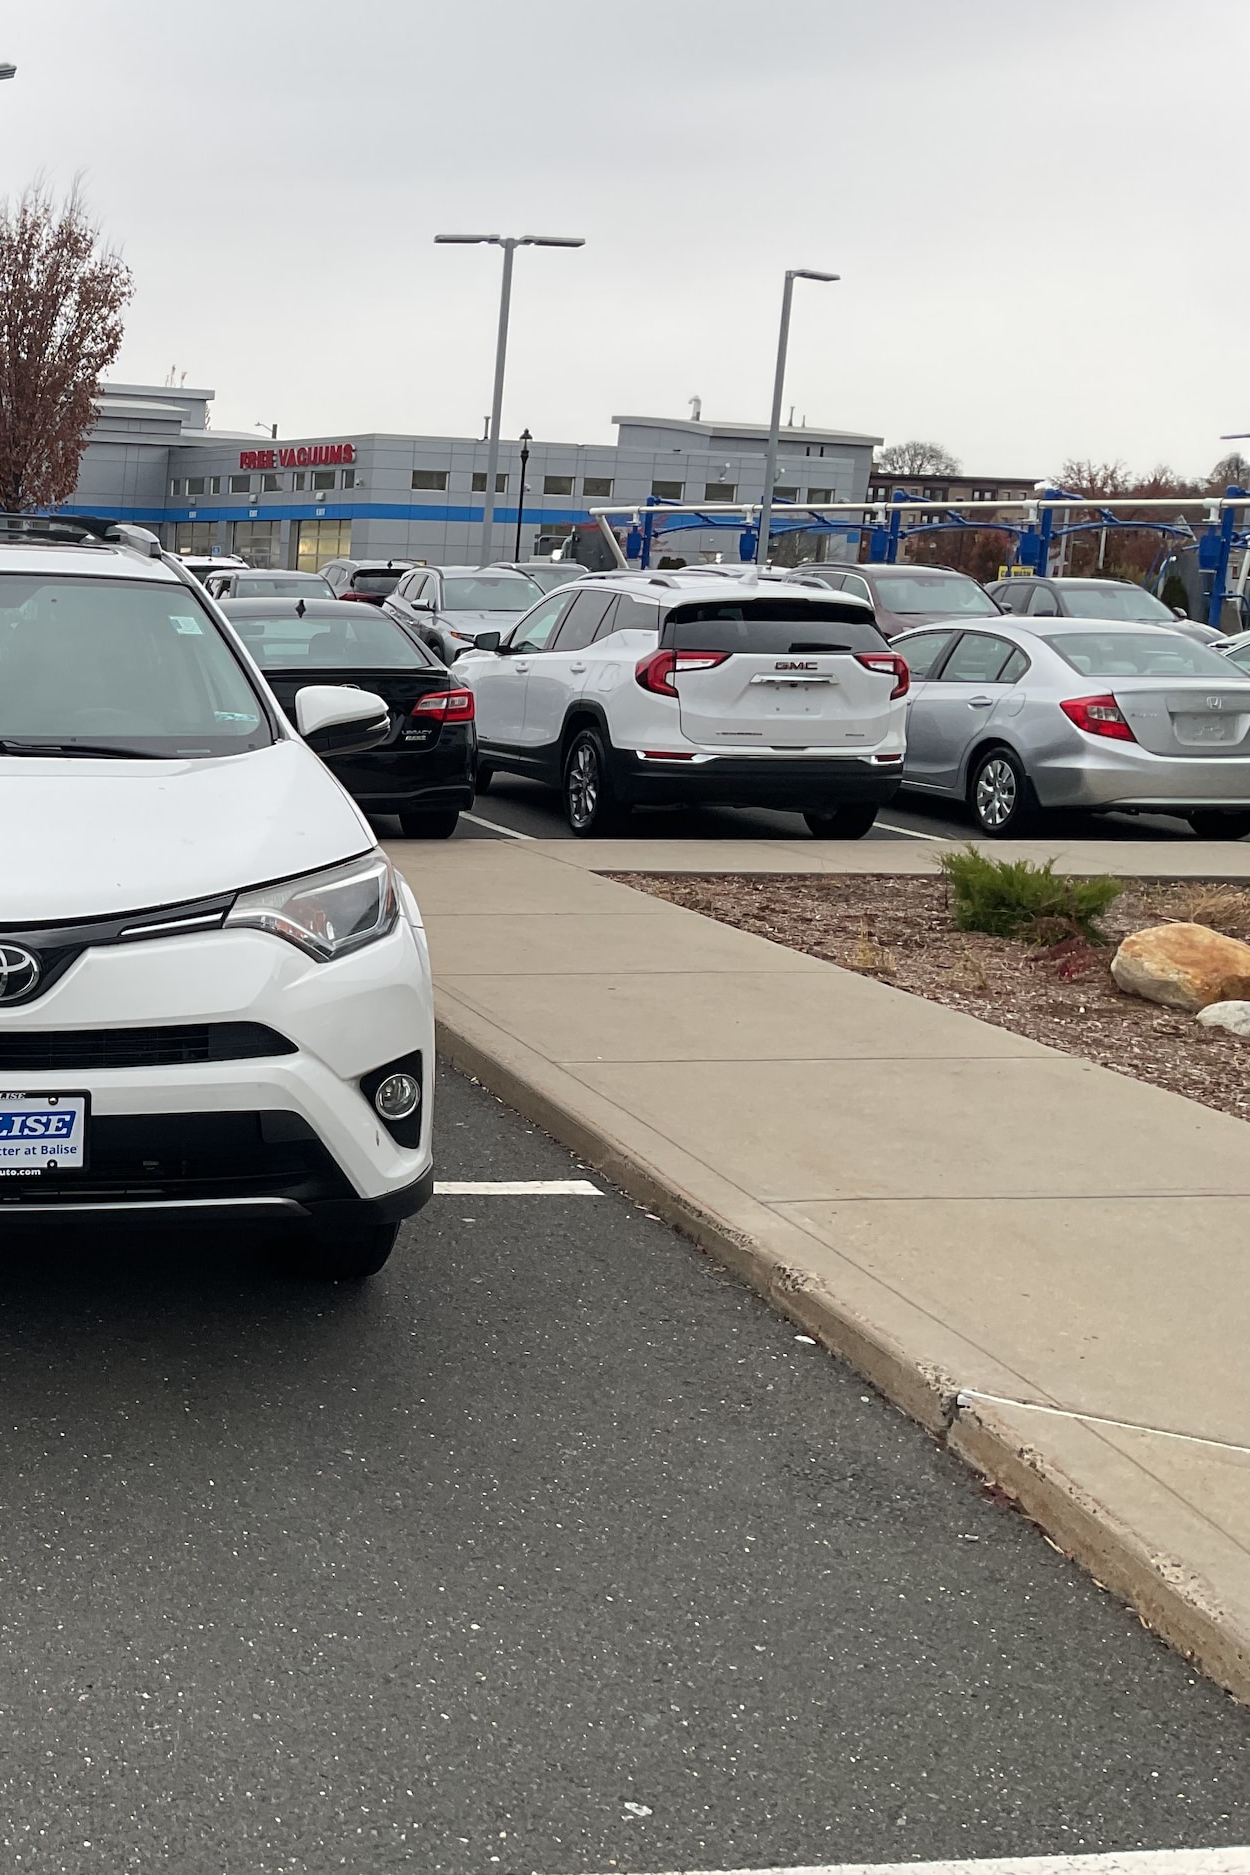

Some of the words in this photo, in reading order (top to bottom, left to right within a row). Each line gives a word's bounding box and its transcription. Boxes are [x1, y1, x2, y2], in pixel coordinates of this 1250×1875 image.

[240, 450, 276, 469] FREE
[278, 443, 356, 468] VACUUMS
[774, 661, 819, 671] GMC
[24, 1146, 37, 1155] at
[40, 1145, 77, 1155] Balise
